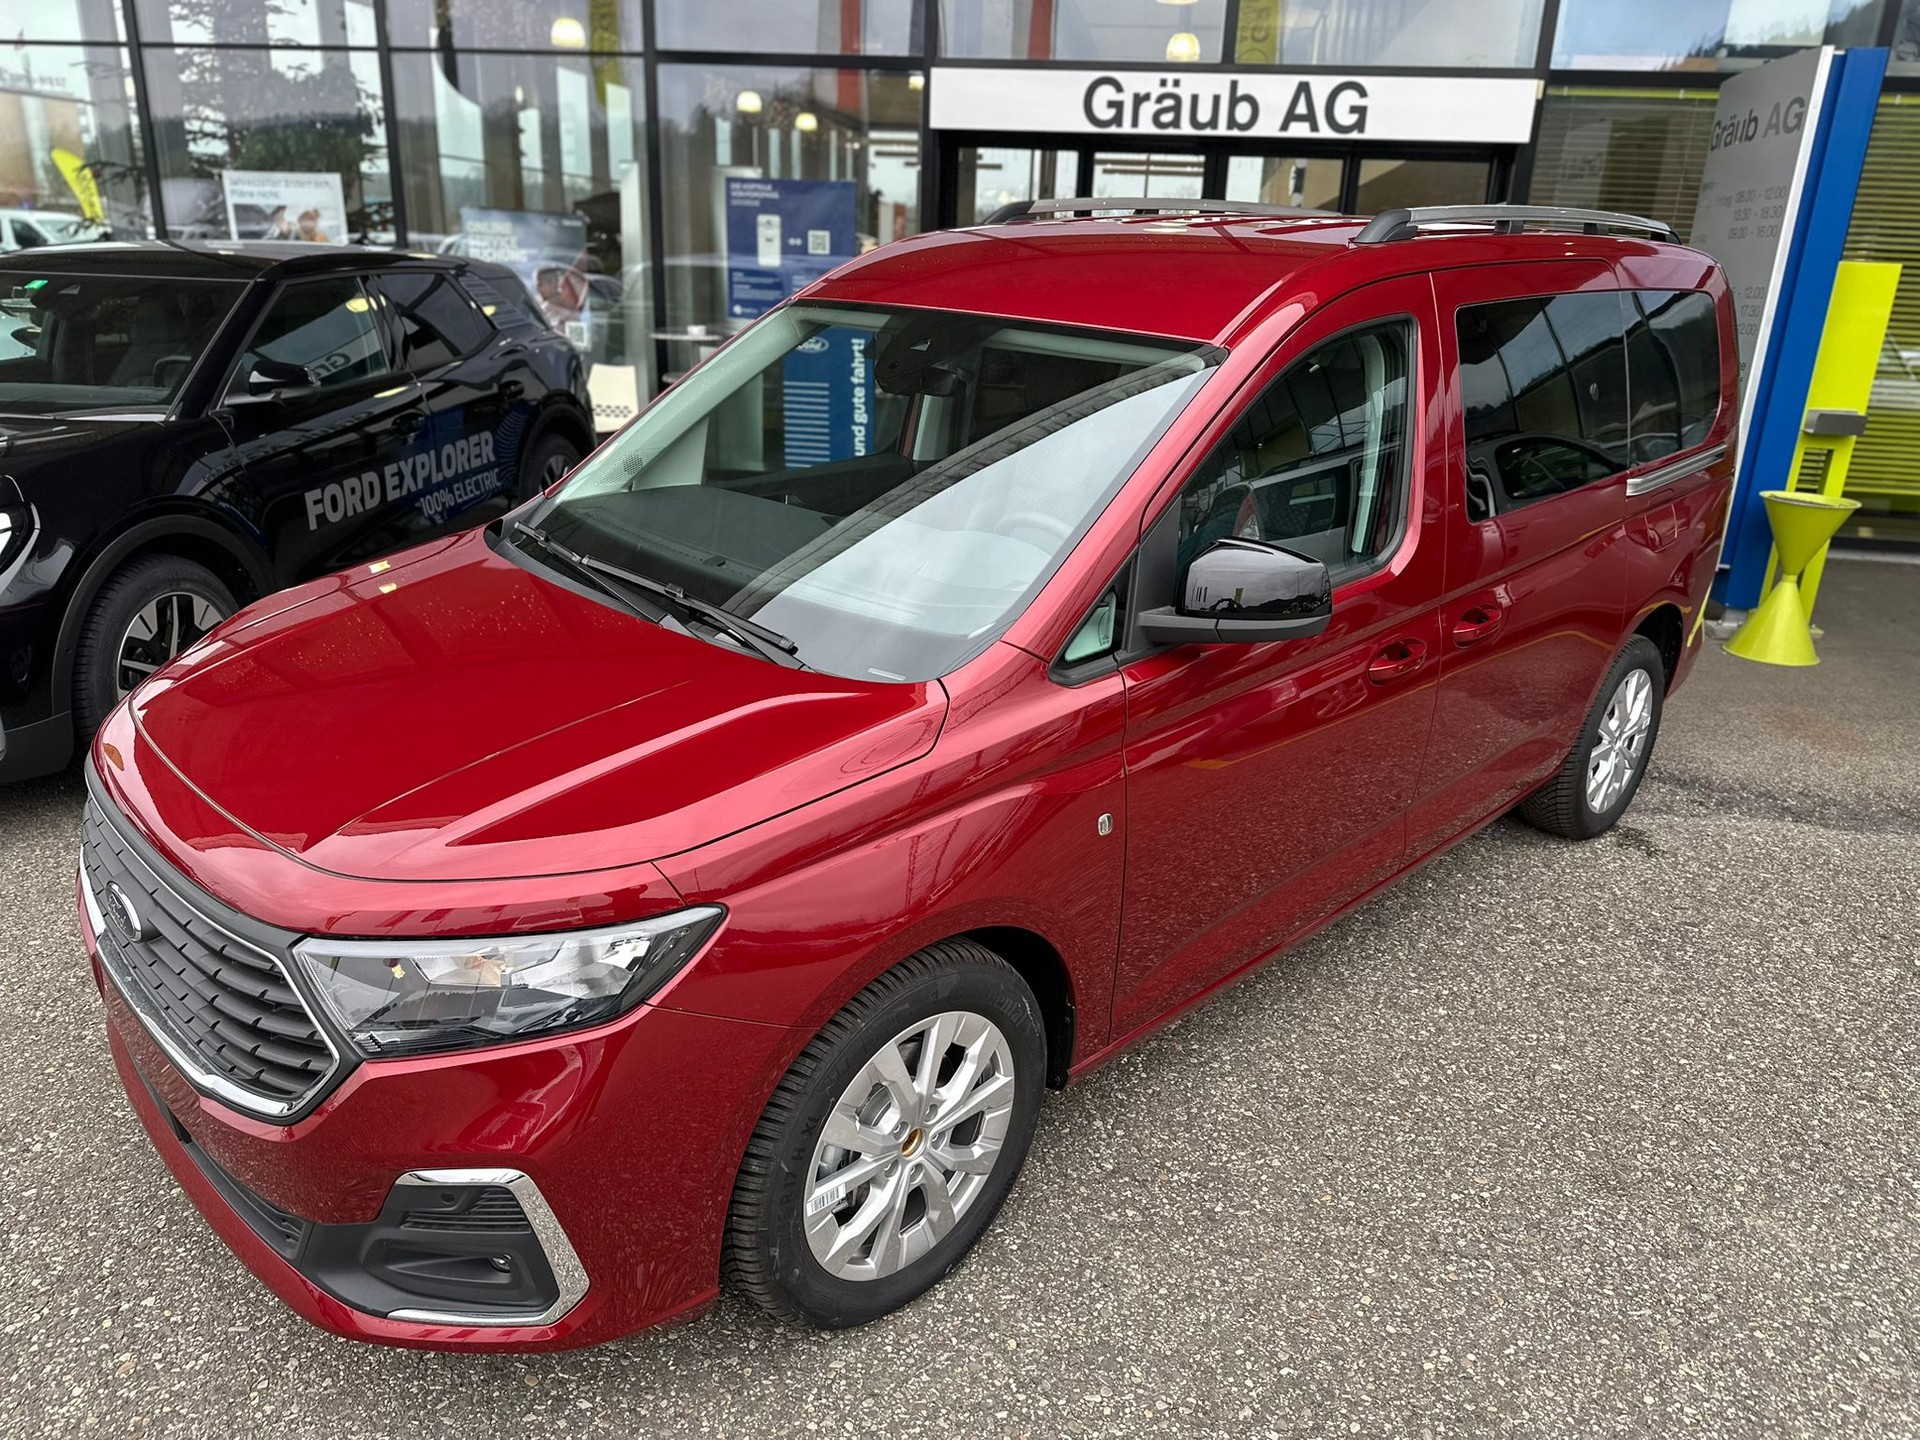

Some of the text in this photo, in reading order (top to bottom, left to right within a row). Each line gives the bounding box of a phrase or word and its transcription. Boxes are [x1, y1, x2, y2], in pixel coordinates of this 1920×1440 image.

[1083, 76, 1369, 134] Gräub AG
[1710, 96, 1806, 151] Gräub AG
[850, 338, 869, 457] und gute fahrt!
[304, 430, 496, 531] FORD EXPLORER
[419, 468, 502, 517] 100% ELECTRIC
